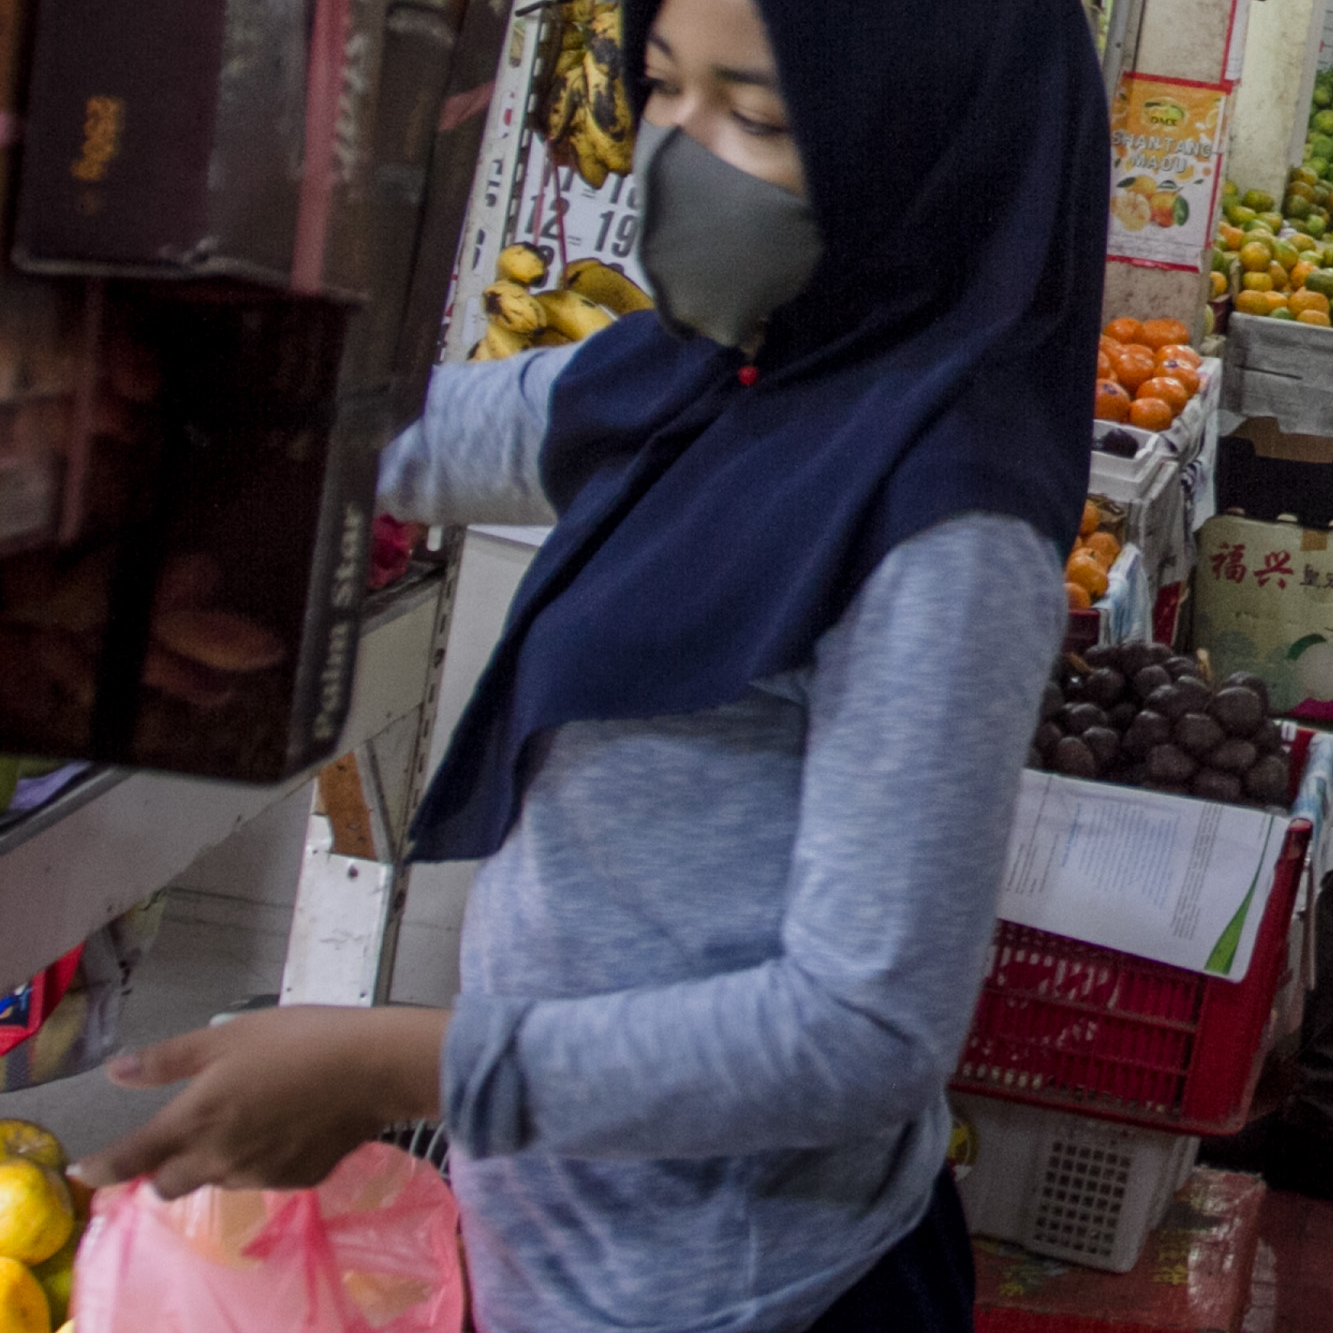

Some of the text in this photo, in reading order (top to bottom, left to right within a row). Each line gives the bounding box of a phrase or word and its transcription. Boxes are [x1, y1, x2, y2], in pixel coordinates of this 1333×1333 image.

[1111, 131, 1213, 158] SHANTANG
[1131, 154, 1188, 174] MADU
[594, 209, 640, 258] 19
